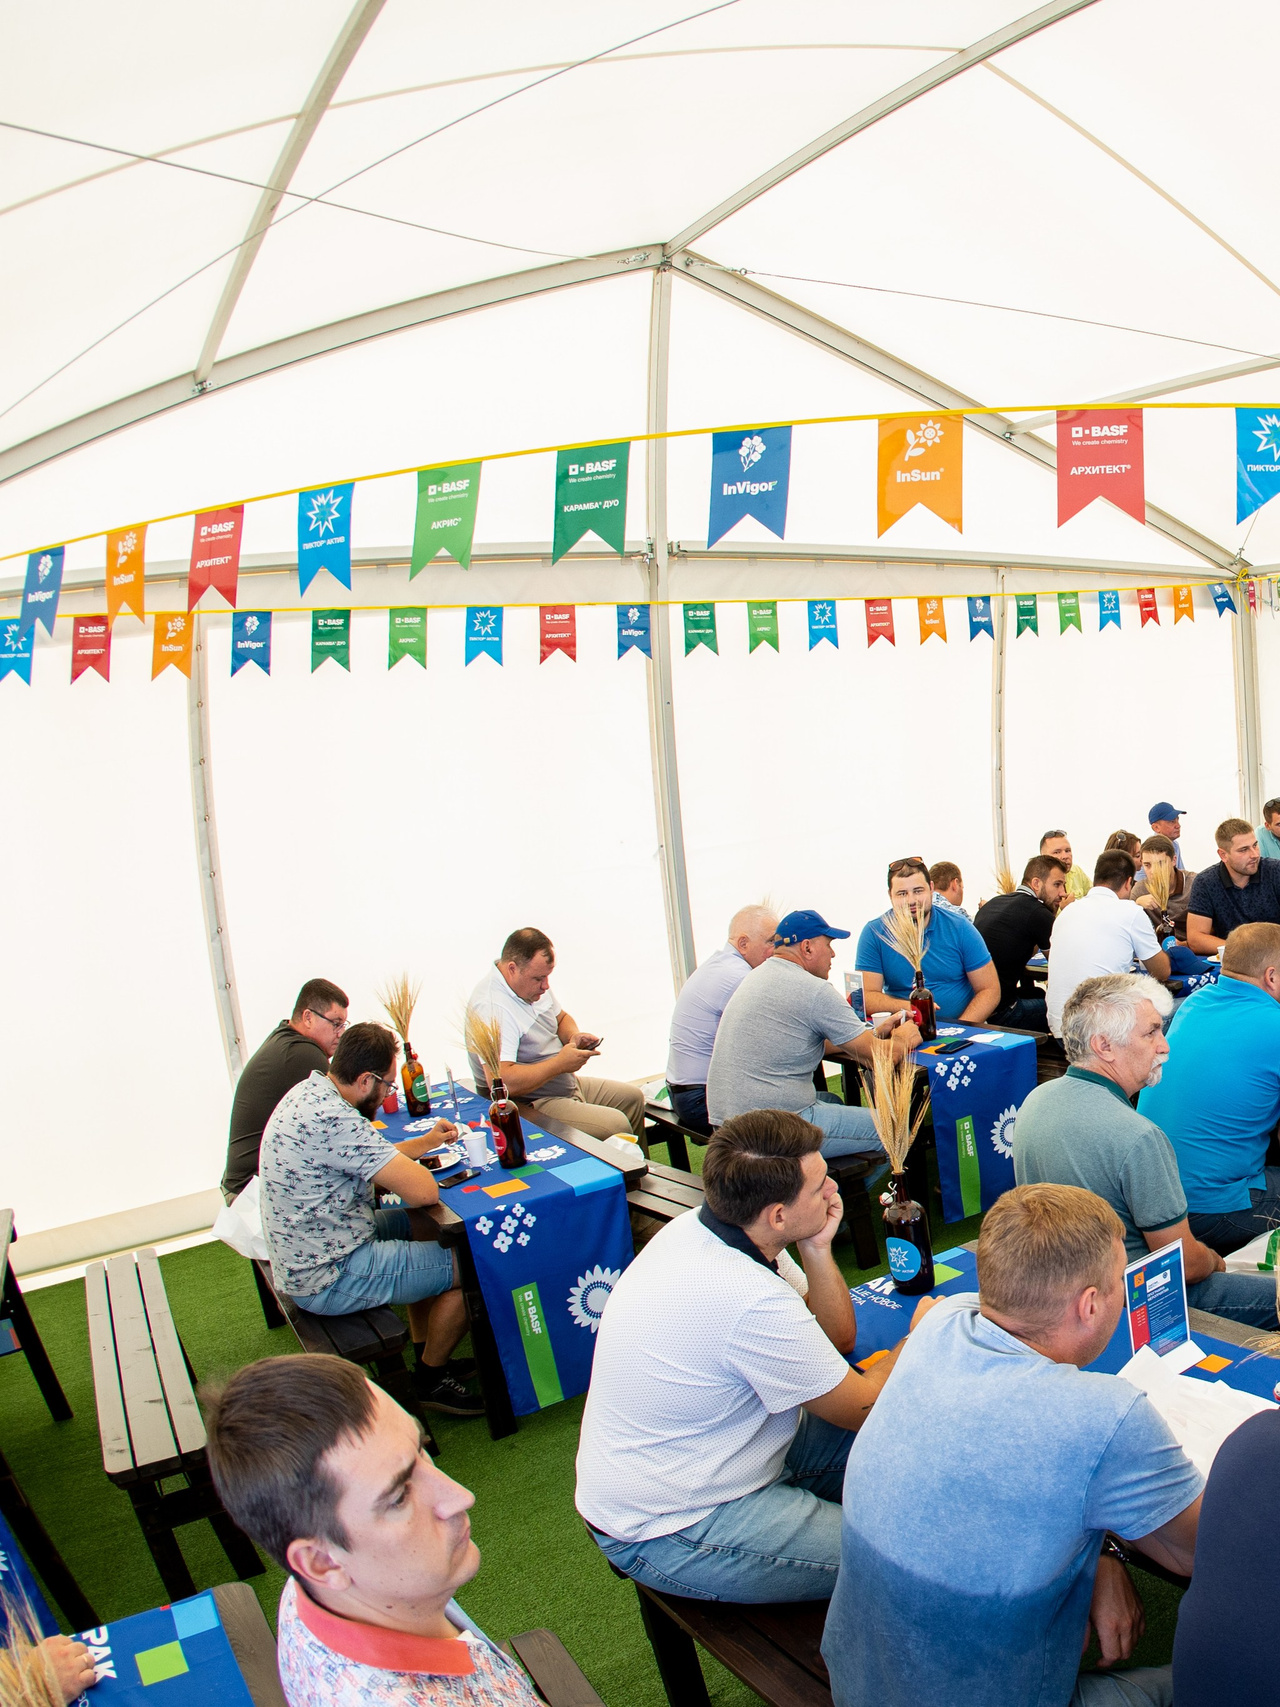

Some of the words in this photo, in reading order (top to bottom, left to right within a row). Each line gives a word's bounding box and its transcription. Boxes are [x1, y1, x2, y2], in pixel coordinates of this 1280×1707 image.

[1092, 424, 1128, 437] BASF
[585, 459, 617, 474] BASF
[442, 479, 470, 493] BASF
[722, 480, 778, 496] InVigor
[603, 499, 620, 510] ДУО
[211, 521, 235, 534] BASF
[327, 536, 346, 546] АКТИВ
[966, 1134, 974, 1157] BASF
[867, 1295, 903, 1310] НОВОЕ
[528, 1305, 542, 1335] BASF
